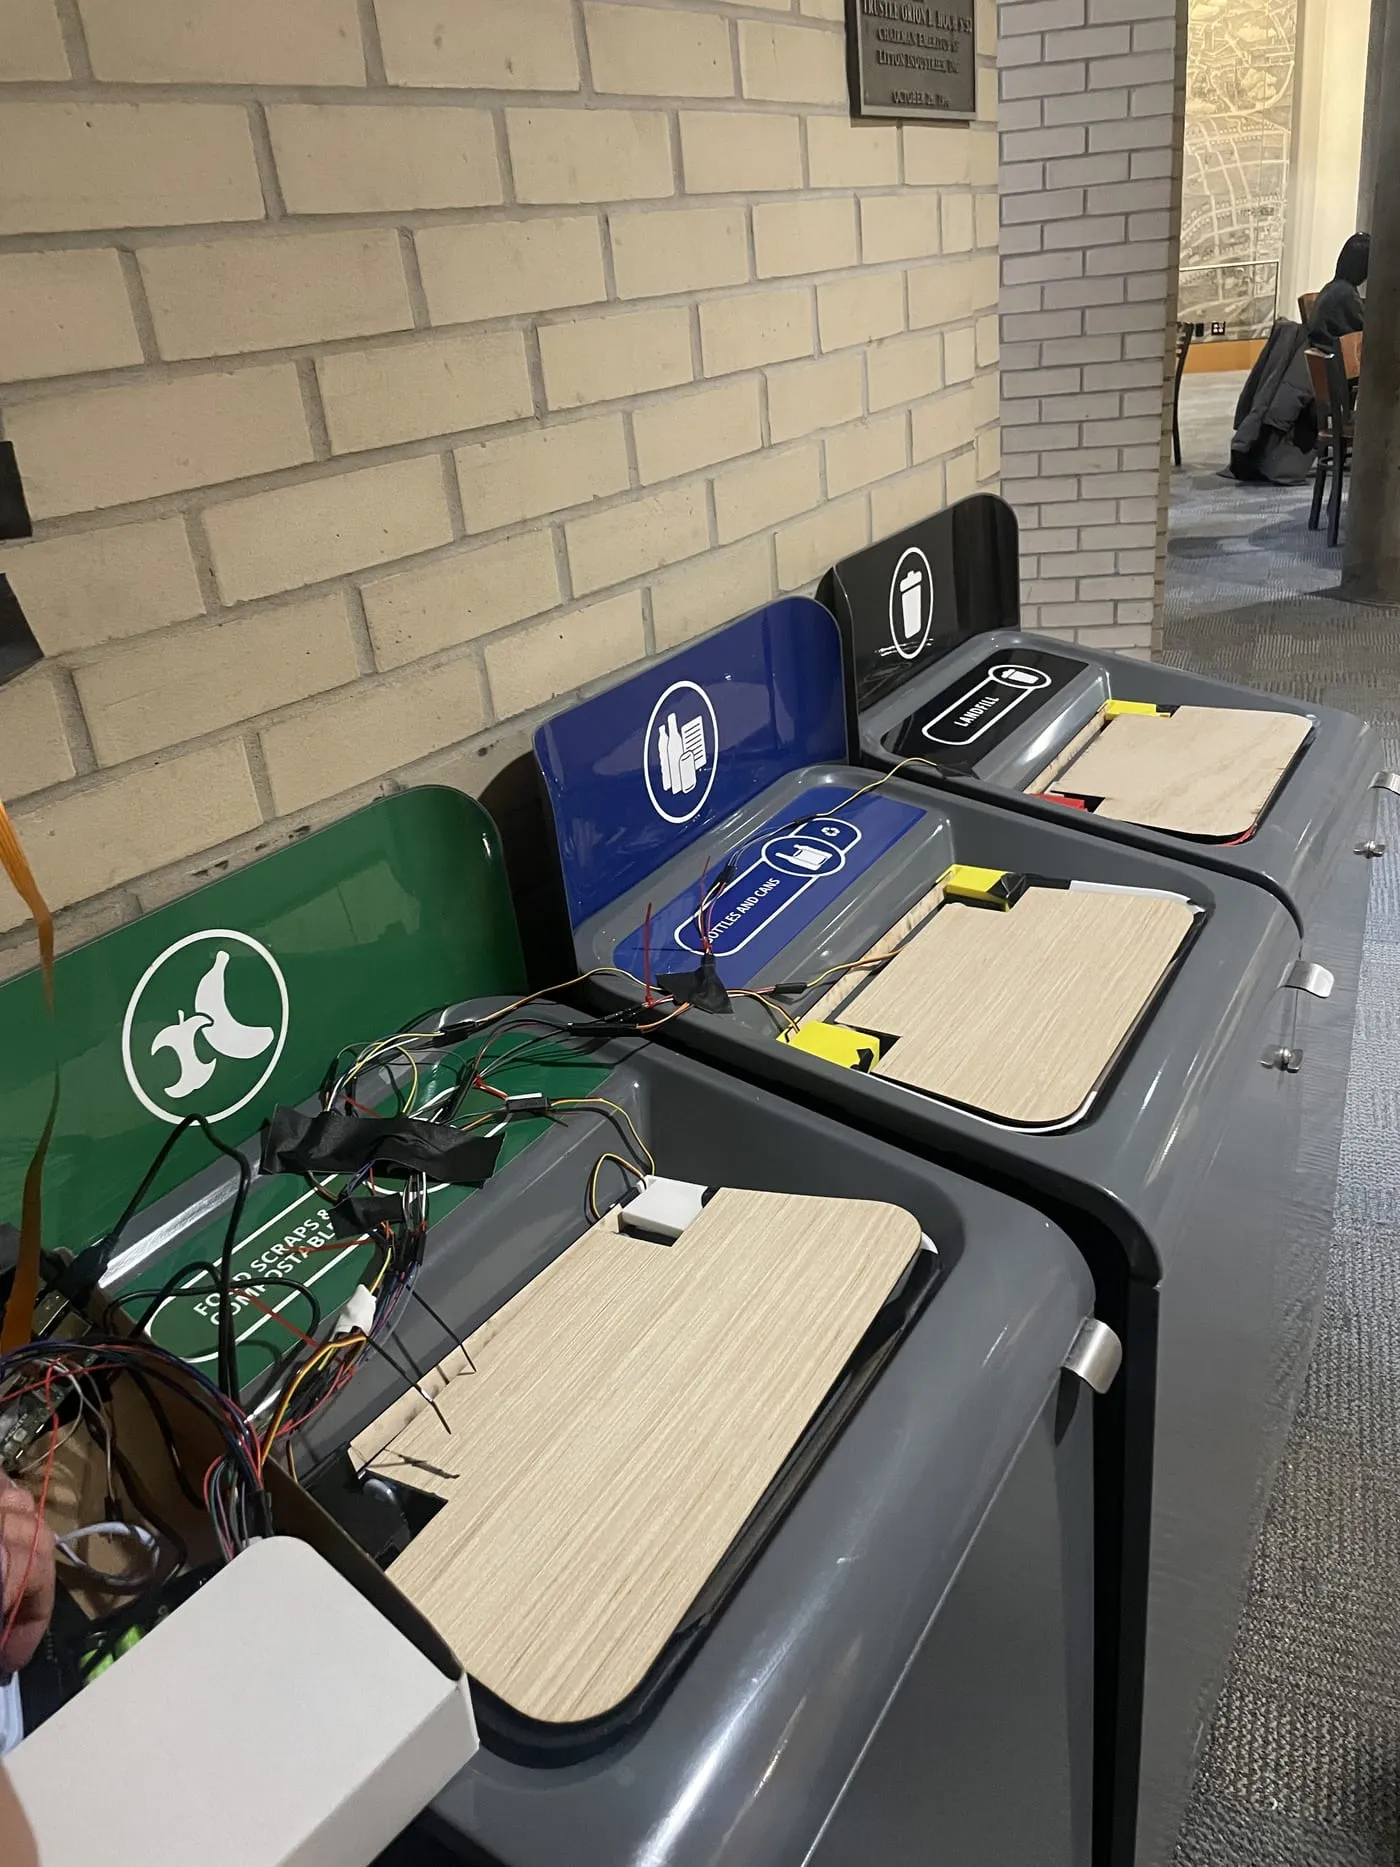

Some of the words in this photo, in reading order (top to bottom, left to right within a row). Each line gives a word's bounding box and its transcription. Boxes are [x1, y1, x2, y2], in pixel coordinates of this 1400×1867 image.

[902, 3, 926, 24] ORION
[877, 50, 906, 67] LITTON
[953, 696, 1000, 728] LANDFILL
[735, 896, 760, 914] AND
[753, 877, 781, 897] CANS
[193, 1270, 253, 1316] FOD
[250, 1218, 321, 1273] SCRAPS
